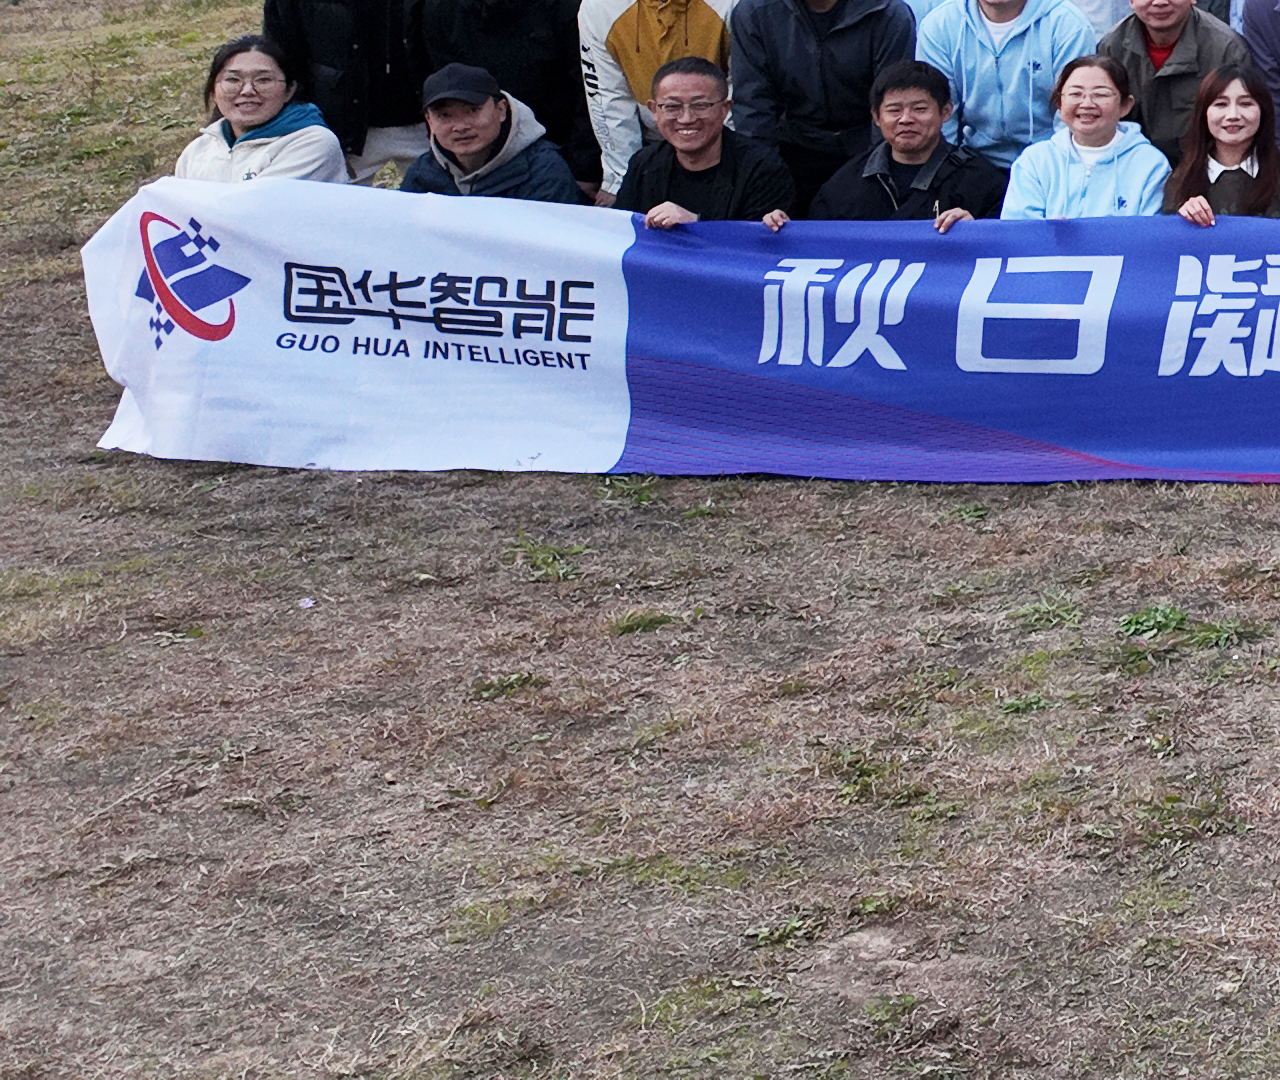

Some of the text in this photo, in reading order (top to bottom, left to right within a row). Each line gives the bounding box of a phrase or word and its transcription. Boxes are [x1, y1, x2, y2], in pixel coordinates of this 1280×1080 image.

[283, 261, 595, 344] 国华智能
[276, 332, 592, 372] GUO HUA INTELLIGENT
